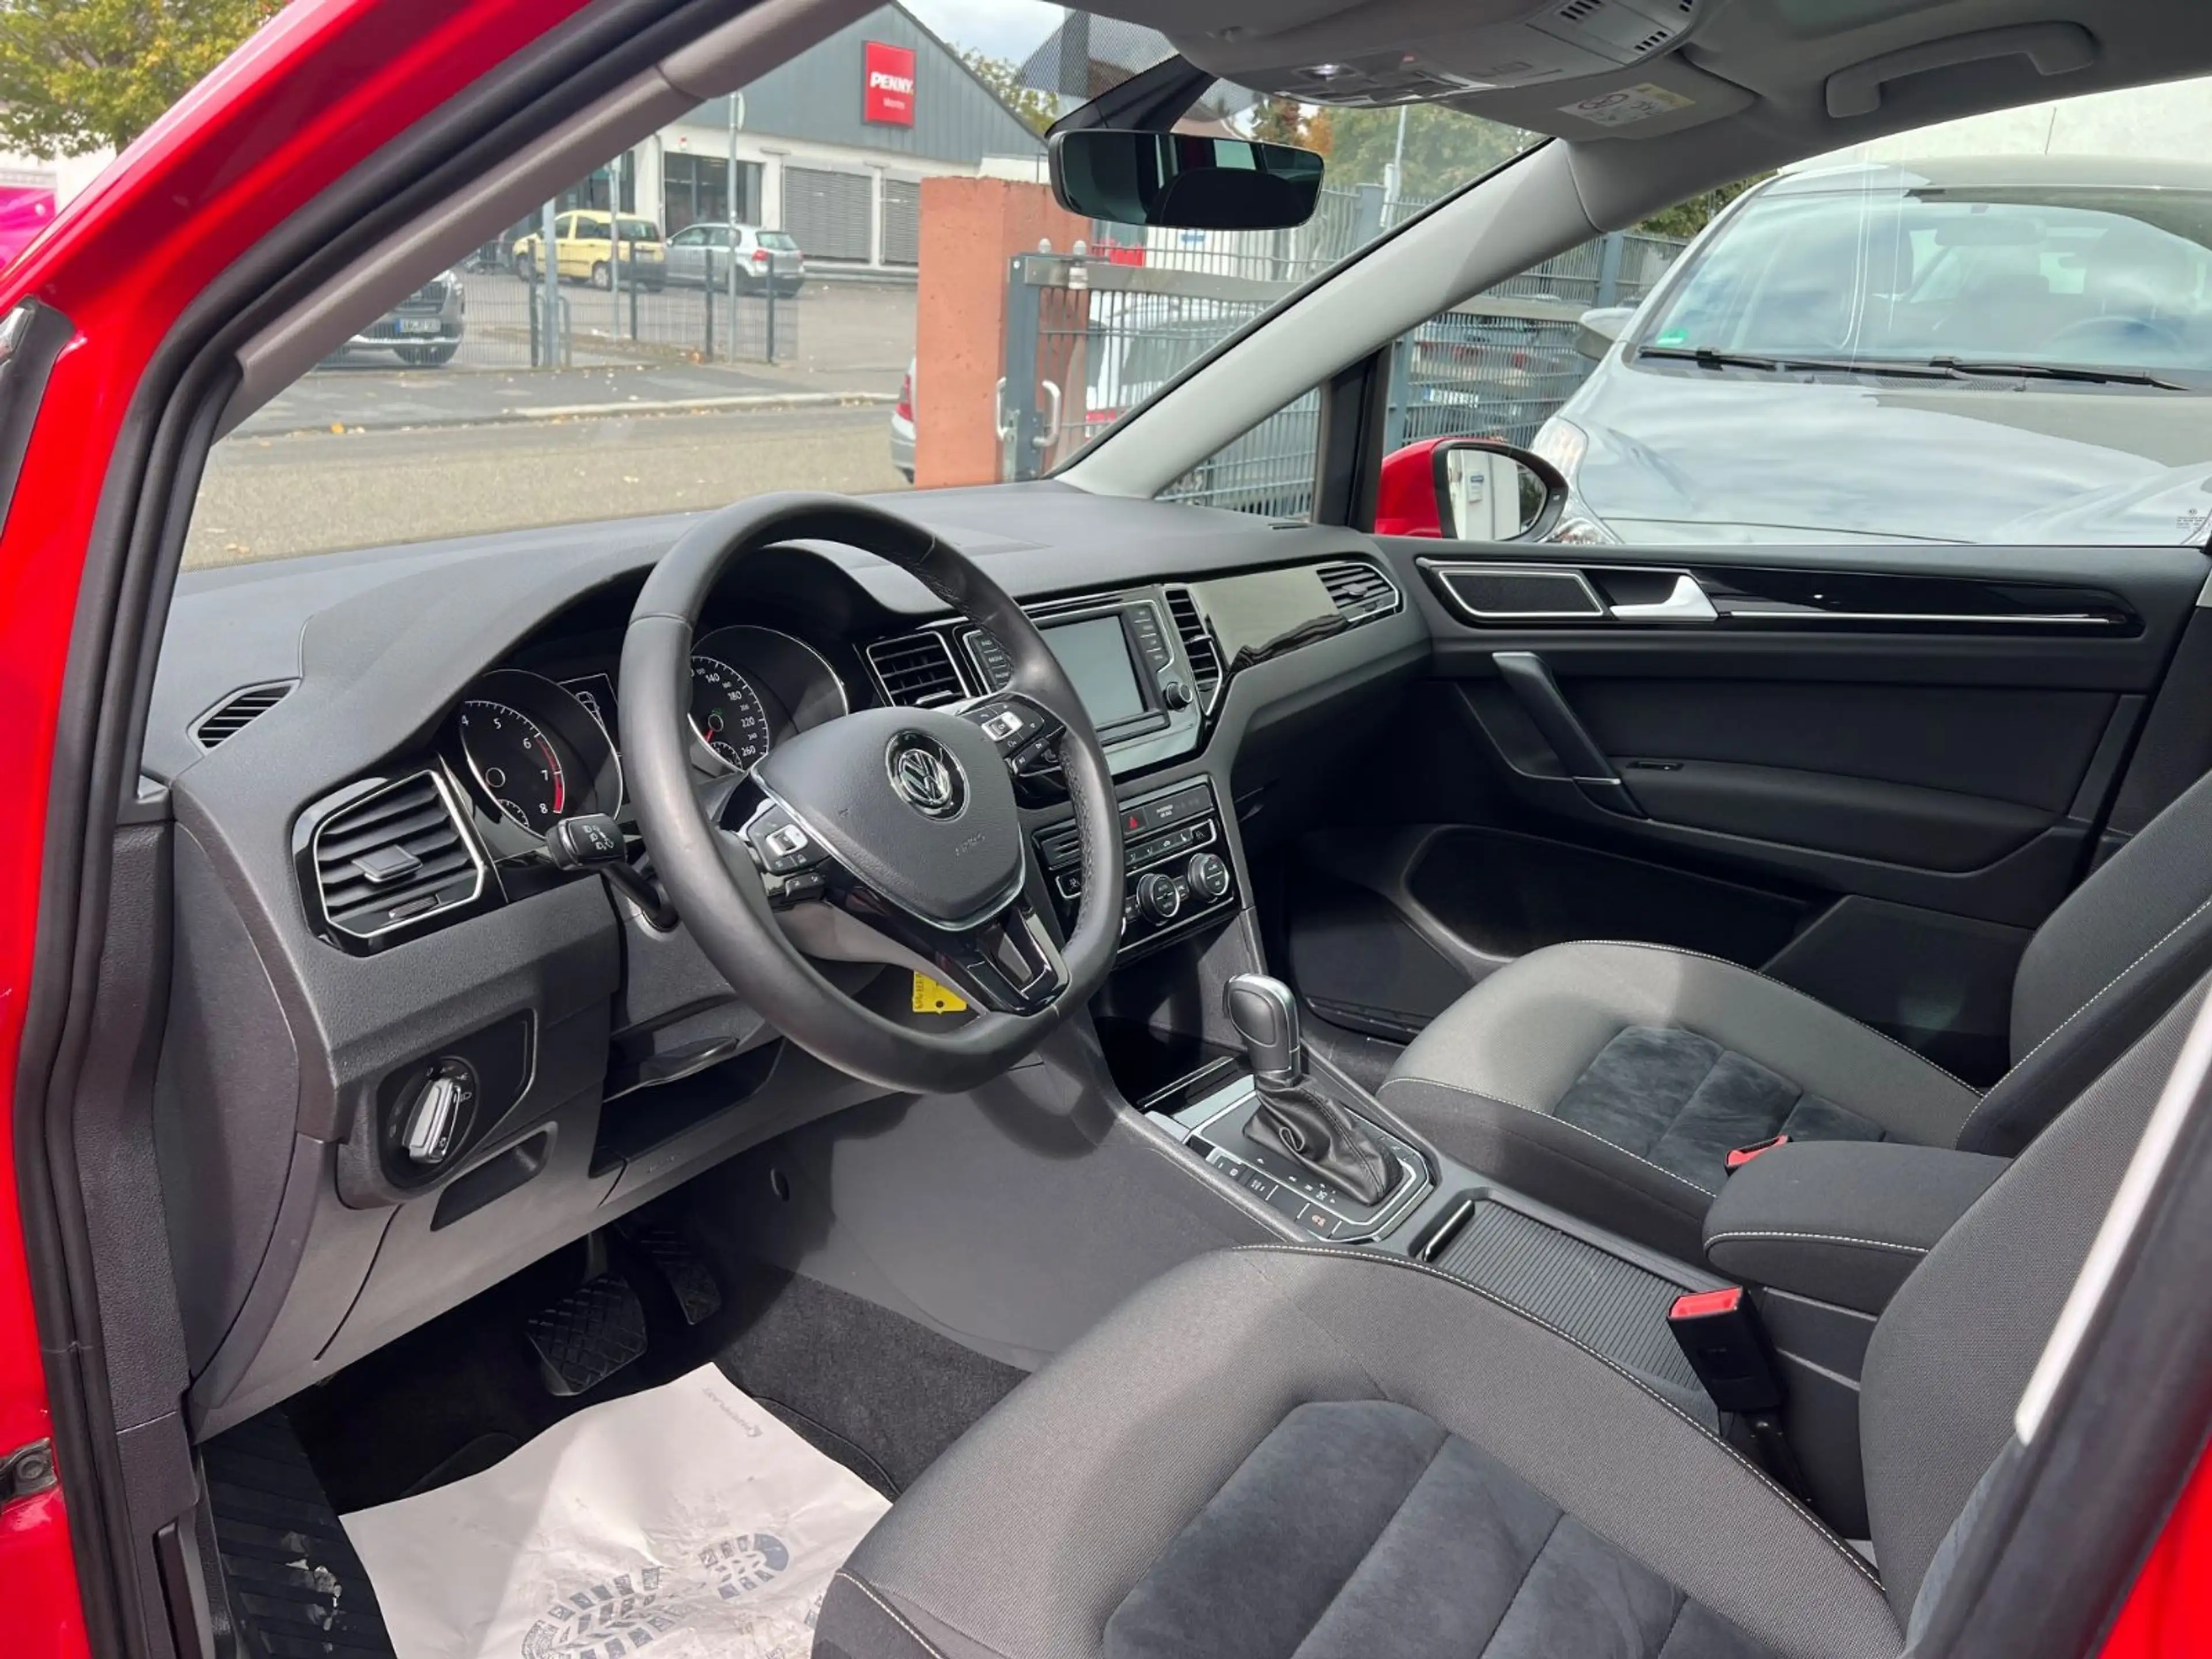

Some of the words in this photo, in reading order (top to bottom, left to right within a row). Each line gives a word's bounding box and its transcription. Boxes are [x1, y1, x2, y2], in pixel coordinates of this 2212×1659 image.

[705, 672, 720, 683] 140
[461, 714, 469, 726] 4
[493, 717, 502, 729] 5
[522, 737, 532, 749] 6
[540, 769, 549, 782] 7
[539, 802, 548, 815] 8
